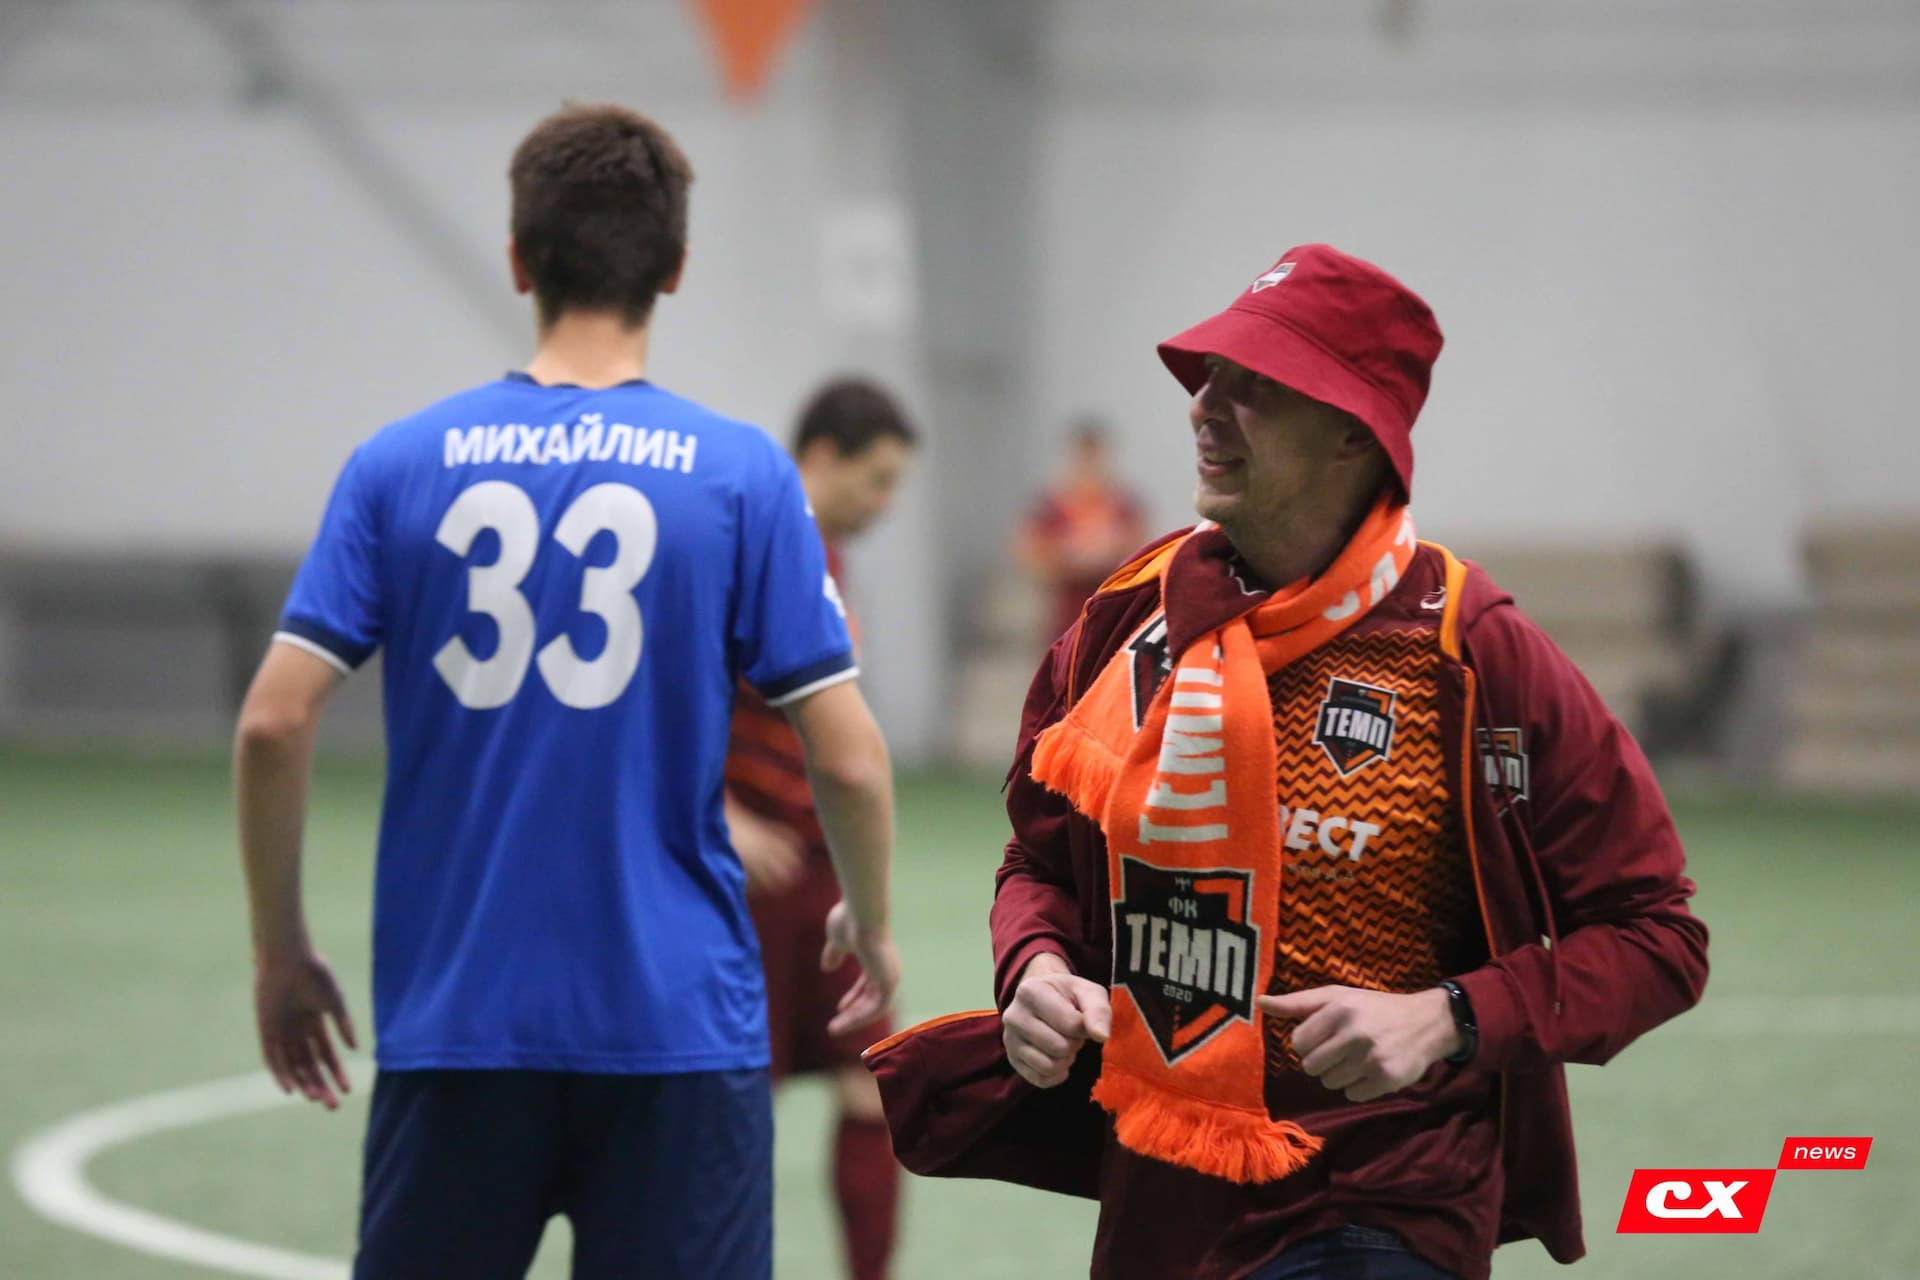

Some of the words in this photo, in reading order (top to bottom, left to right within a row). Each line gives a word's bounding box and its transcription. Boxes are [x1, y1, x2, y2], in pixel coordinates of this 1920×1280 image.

[444, 413, 698, 473] МИХАЙЛИН
[432, 480, 658, 710] 33
[1324, 707, 1388, 749] ТЕМП
[1168, 896, 1198, 919] ФК
[1126, 913, 1247, 1001] ТЕМП
